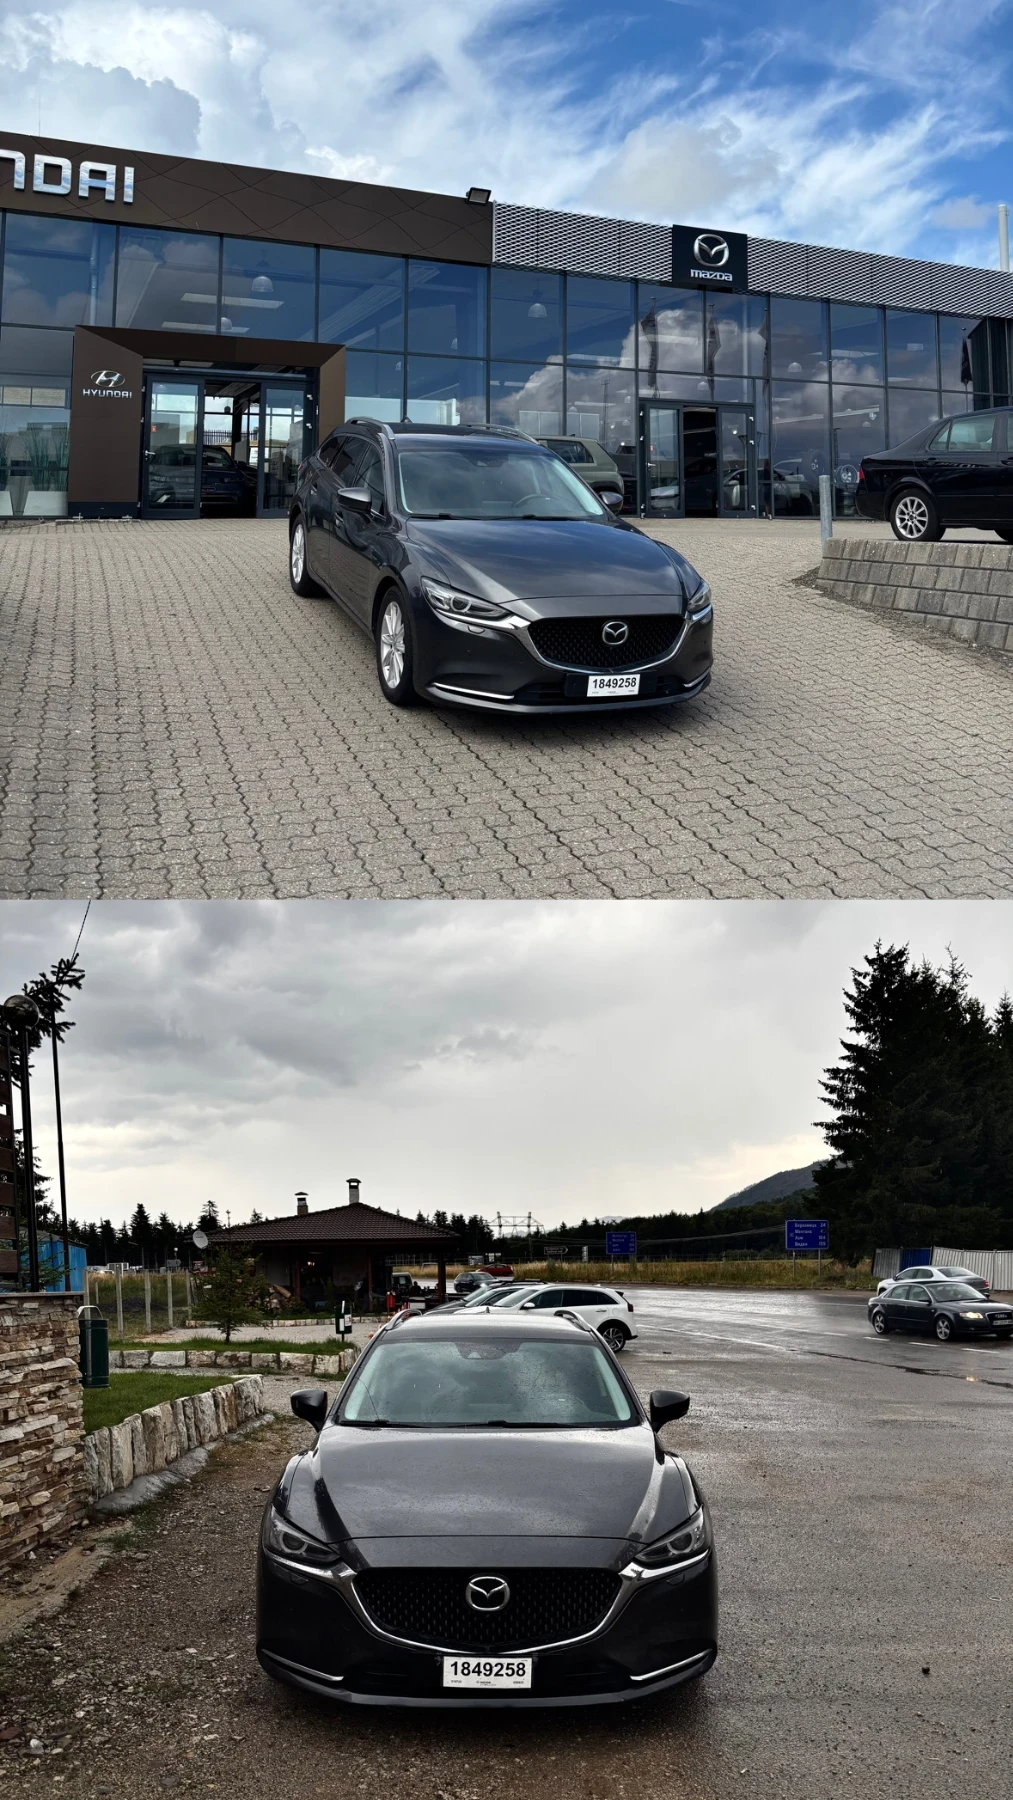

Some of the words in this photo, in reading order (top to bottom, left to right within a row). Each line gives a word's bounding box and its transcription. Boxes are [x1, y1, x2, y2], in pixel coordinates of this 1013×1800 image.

[82, 388, 132, 399] HYUNDAI
[592, 677, 637, 689] 1849258
[450, 1661, 527, 1677] 1849258
